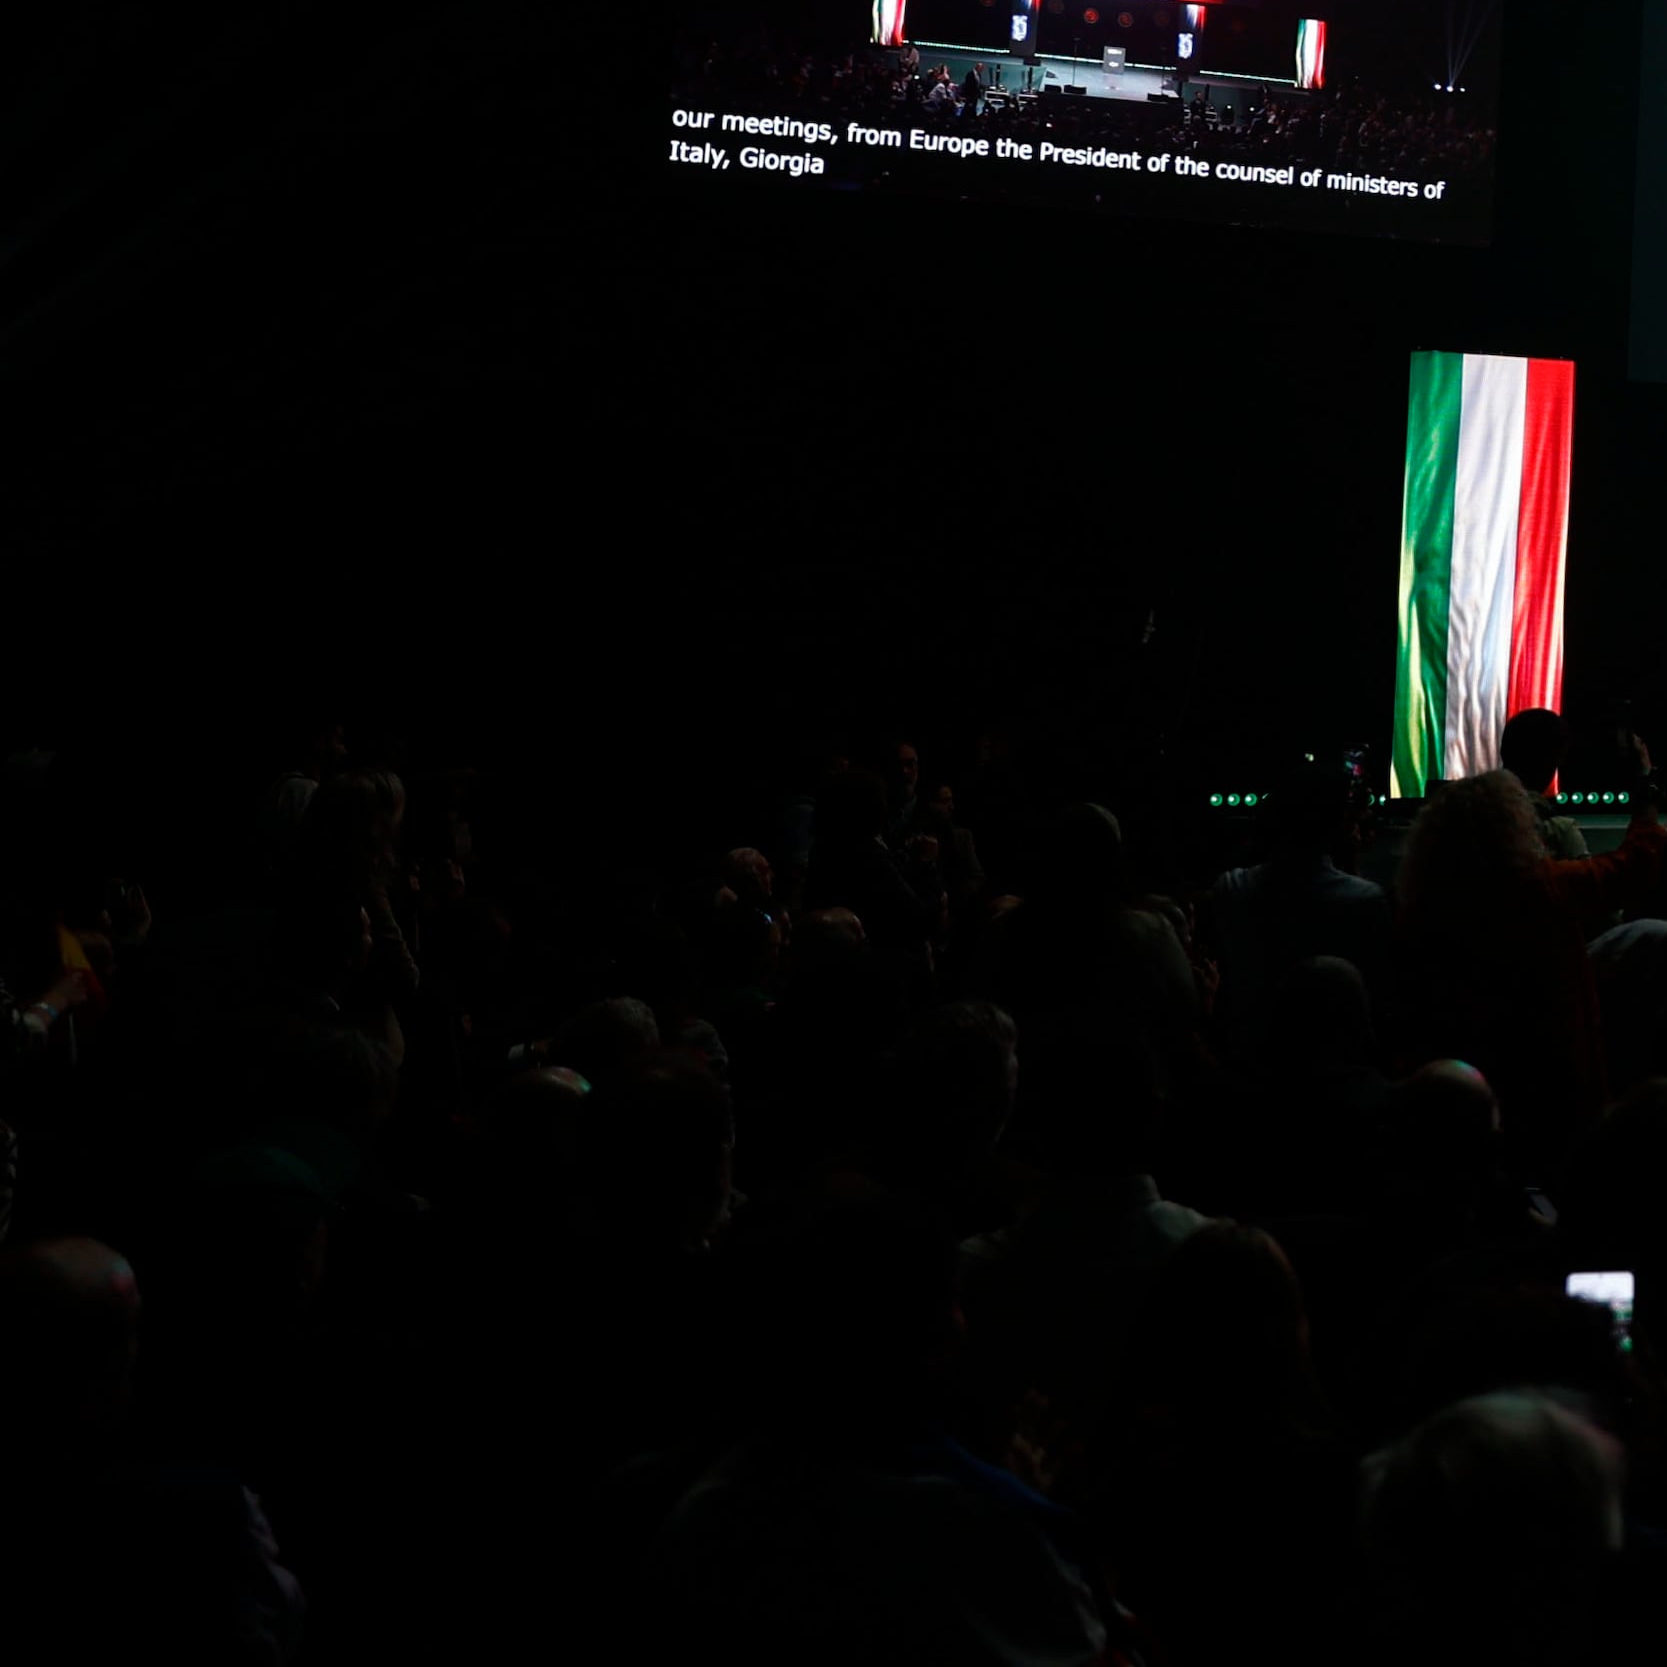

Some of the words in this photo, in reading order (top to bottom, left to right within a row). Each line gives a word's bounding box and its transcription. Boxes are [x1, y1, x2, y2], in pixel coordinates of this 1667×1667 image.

[668, 139, 731, 170] Italy,
[739, 146, 825, 177] Giorgia
[672, 109, 716, 129] our
[721, 114, 839, 146] meetings,
[847, 122, 902, 147] from
[909, 128, 990, 159] Europe
[995, 137, 1033, 161] the
[1039, 141, 1142, 171] President
[1146, 152, 1171, 173] of
[1174, 155, 1210, 178] the
[1215, 162, 1295, 185] counsel
[1299, 168, 1323, 188] of
[1326, 172, 1419, 198] ministers
[1423, 180, 1446, 200] of
